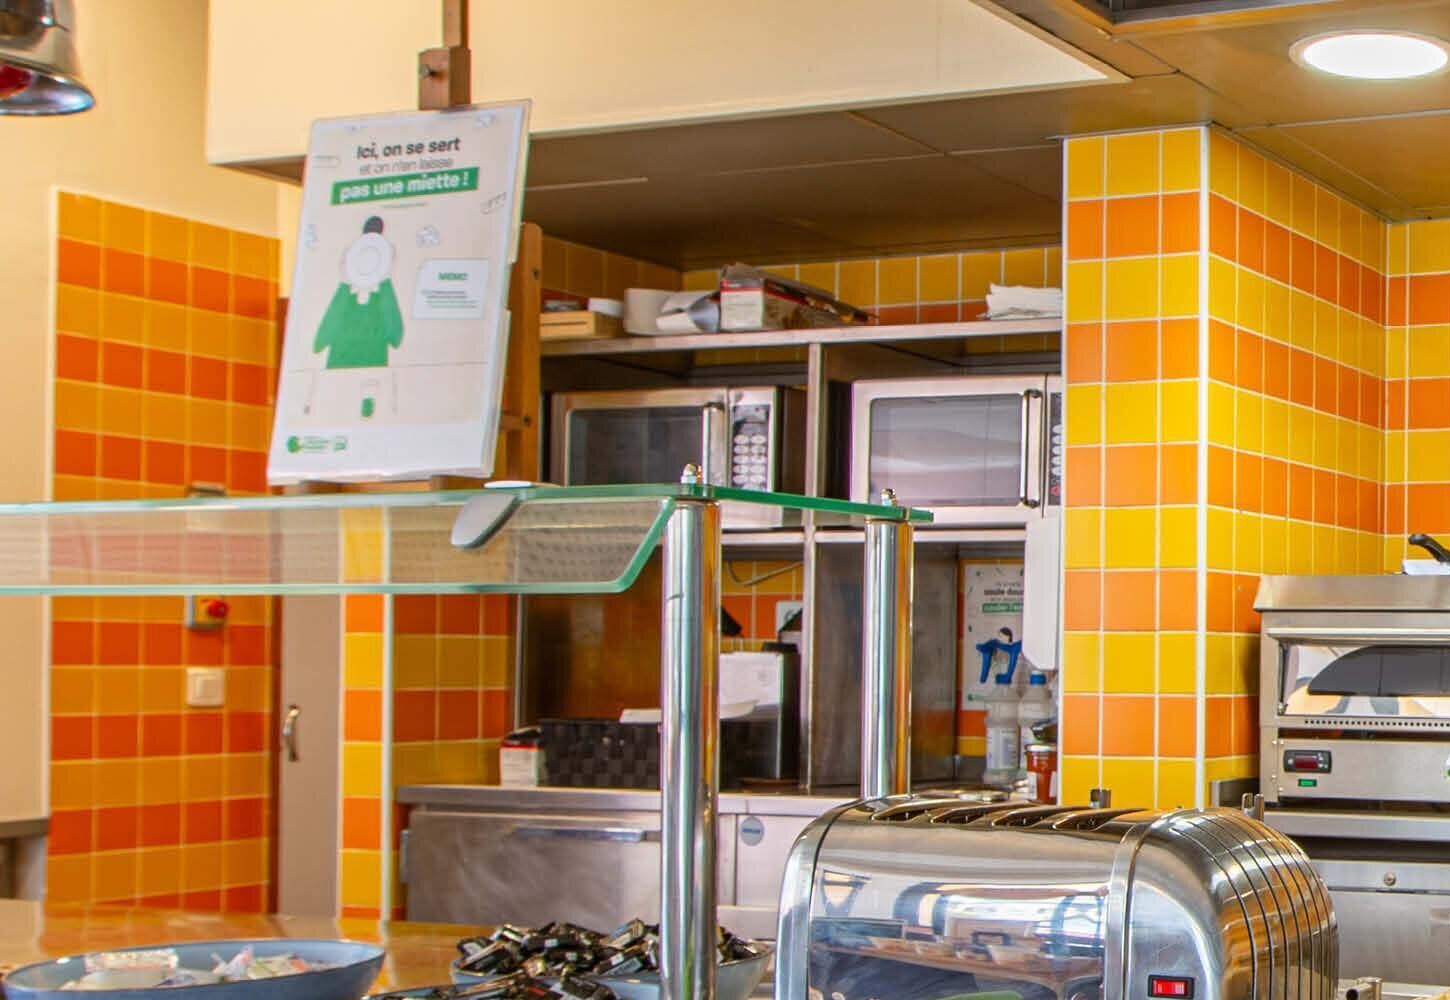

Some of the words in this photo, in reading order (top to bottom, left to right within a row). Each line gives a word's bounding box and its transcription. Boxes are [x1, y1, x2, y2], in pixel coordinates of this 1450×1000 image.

[357, 142, 379, 160] Ici,
[383, 144, 401, 157] on
[406, 142, 424, 155] se
[429, 137, 461, 153] sert
[341, 184, 370, 203] pas
[373, 181, 403, 196] une
[408, 173, 460, 192] miette
